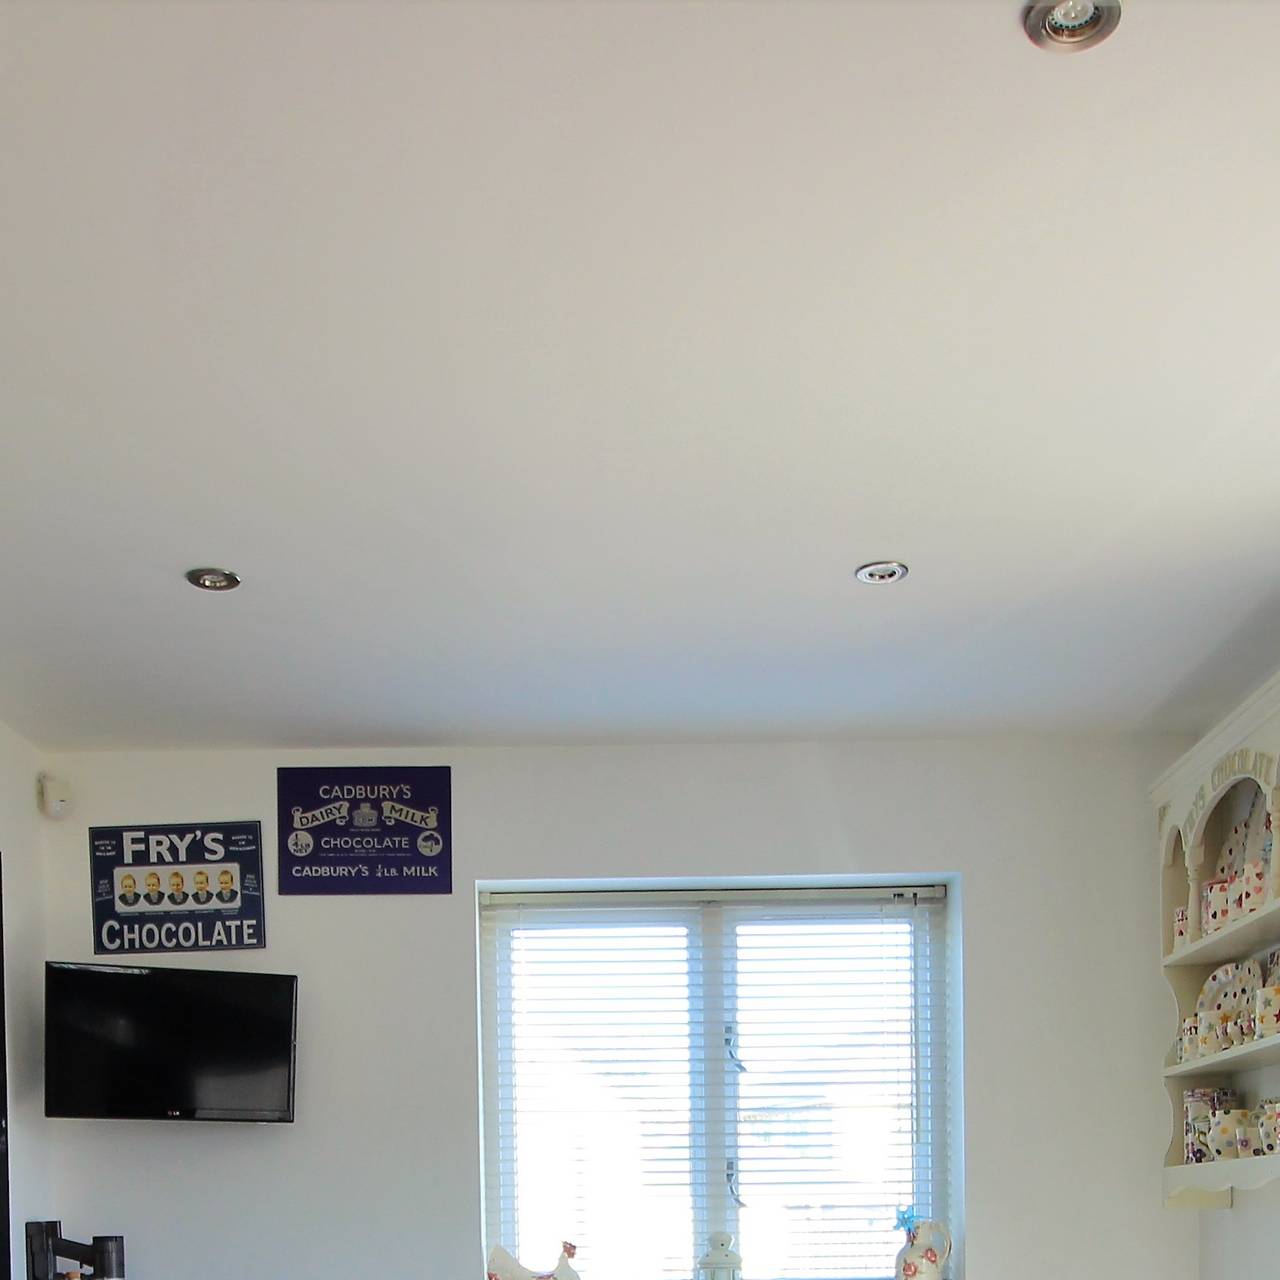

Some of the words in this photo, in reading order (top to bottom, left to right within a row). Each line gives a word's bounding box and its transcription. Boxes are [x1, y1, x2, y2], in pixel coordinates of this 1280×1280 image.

[319, 784, 411, 799] CADBURY'S
[299, 804, 344, 827] DAIRY
[389, 804, 431, 827] MILK
[122, 830, 225, 864] FRY'S
[320, 837, 409, 849] CHOCOLATE
[292, 864, 369, 877] CADBURY'S
[403, 866, 438, 877] MILK
[101, 919, 257, 950] CHOCOLATE
